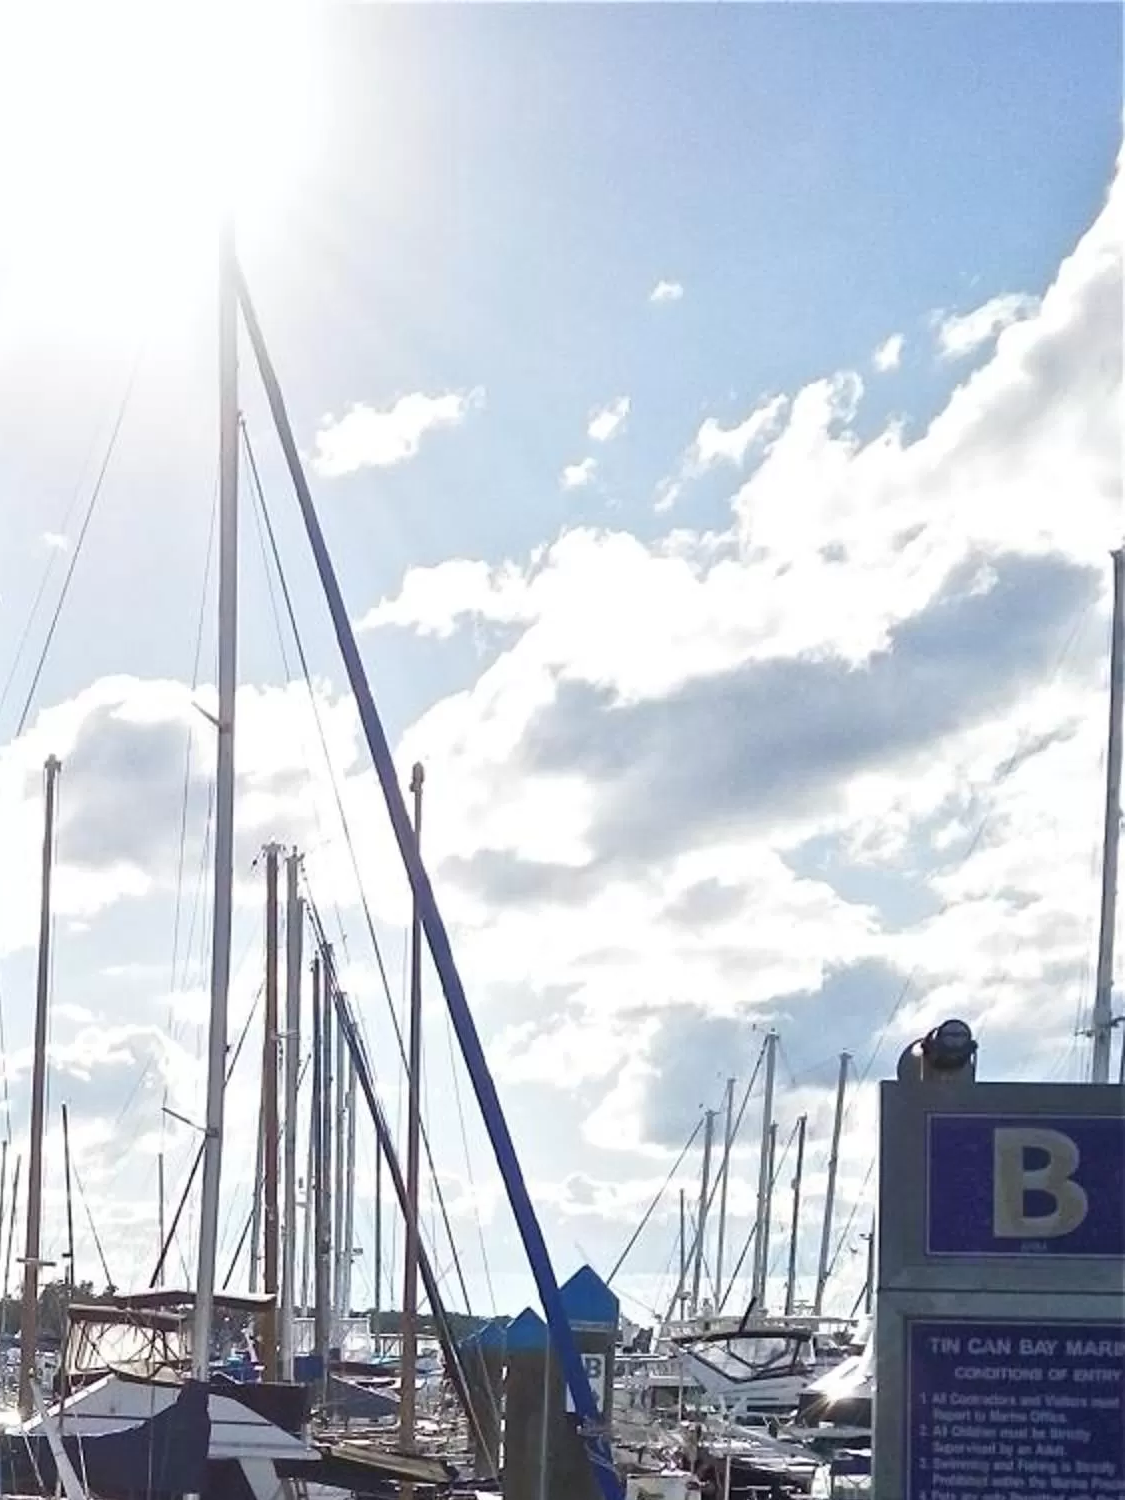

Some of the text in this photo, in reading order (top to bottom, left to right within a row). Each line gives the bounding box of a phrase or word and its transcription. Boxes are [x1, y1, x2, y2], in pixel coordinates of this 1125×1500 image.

[994, 1127, 1089, 1239] B
[931, 1338, 960, 1354] TIN
[968, 1338, 1011, 1355] CAN
[1018, 1339, 1058, 1356] BAY
[954, 1367, 1043, 1381] CONDITIONS
[1048, 1368, 1067, 1381] OF
